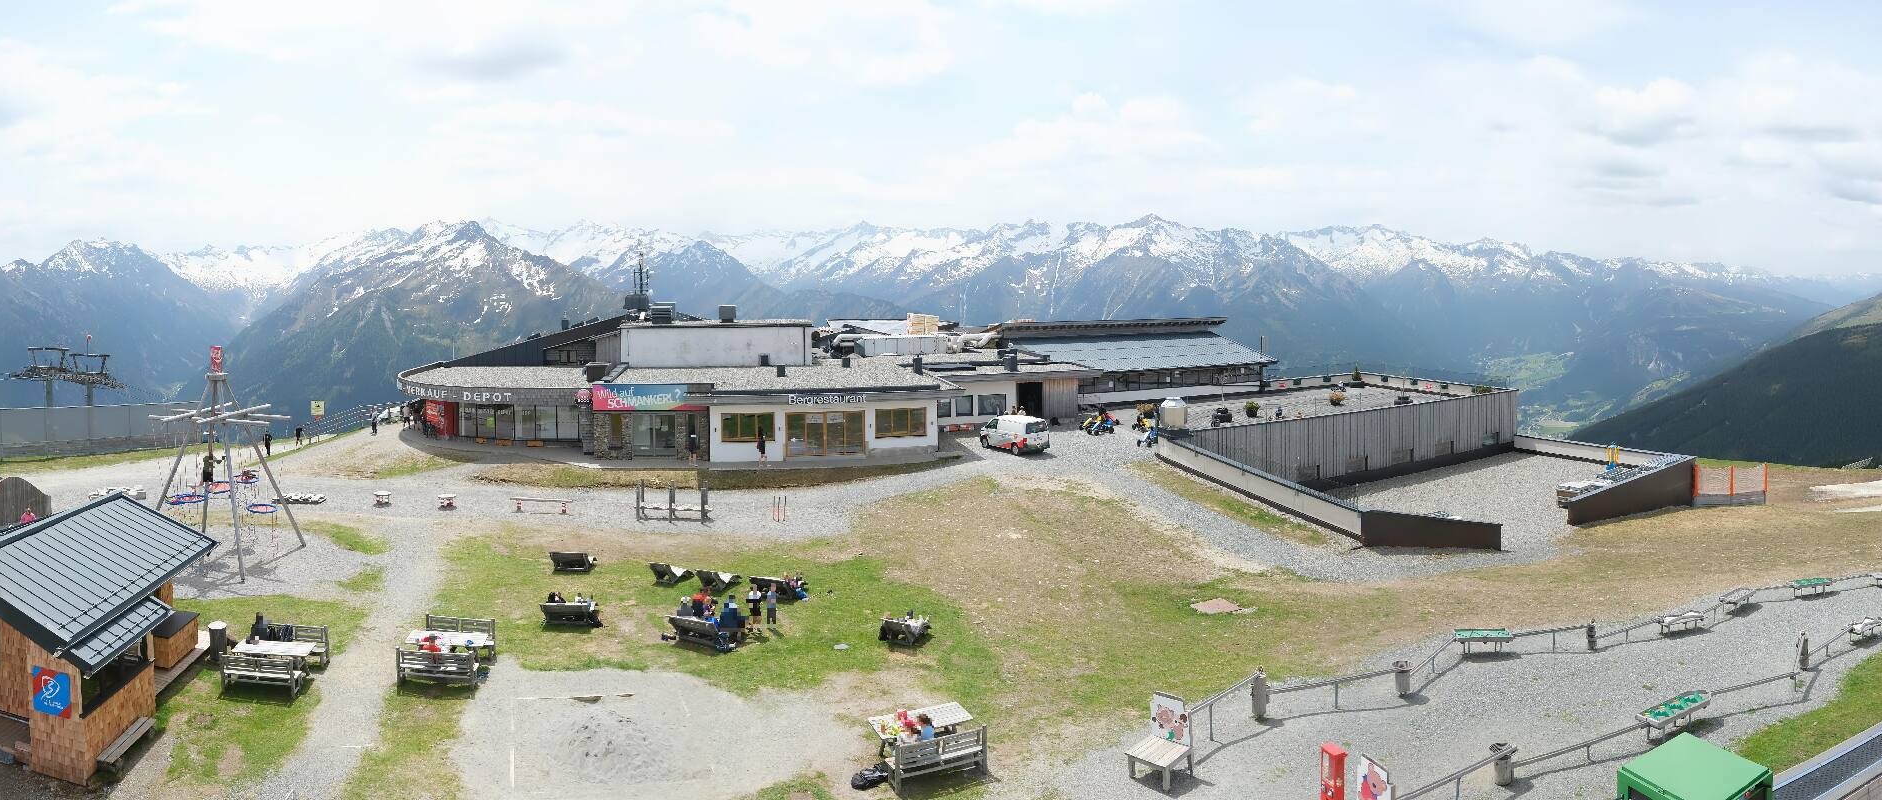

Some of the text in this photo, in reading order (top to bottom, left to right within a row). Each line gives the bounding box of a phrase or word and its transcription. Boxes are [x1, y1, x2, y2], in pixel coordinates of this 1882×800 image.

[406, 385, 448, 399] VERKAUF
[463, 391, 512, 402] DEPOT
[596, 386, 635, 400] Wild auf
[788, 394, 867, 406] Bergrestaurant
